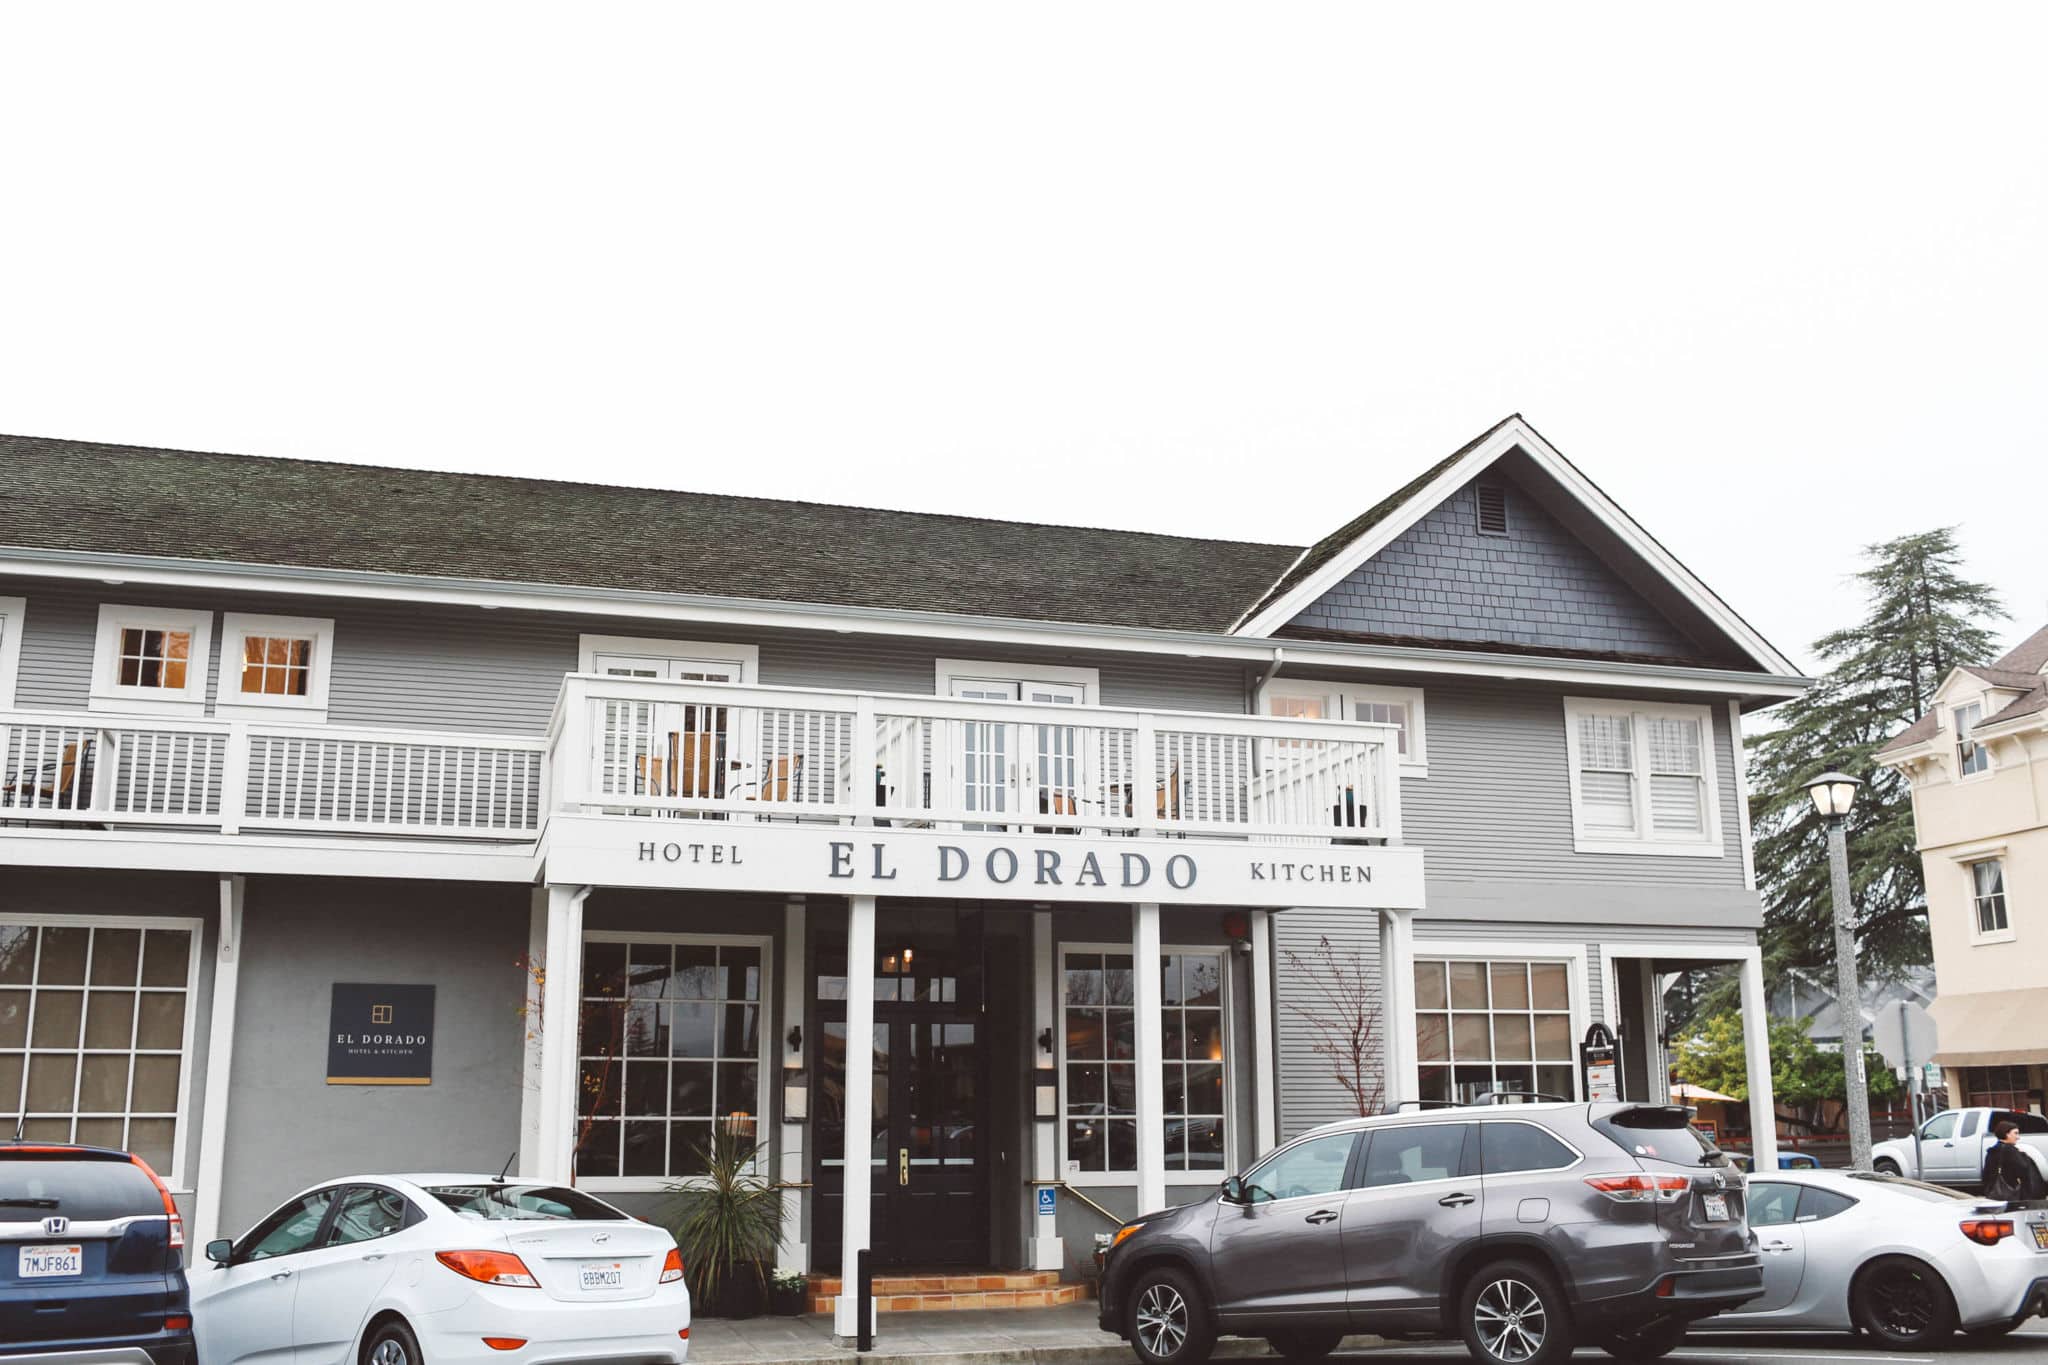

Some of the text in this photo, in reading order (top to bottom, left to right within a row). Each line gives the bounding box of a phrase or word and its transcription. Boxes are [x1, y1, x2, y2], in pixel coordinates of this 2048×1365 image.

[638, 841, 743, 865] HOTEL
[828, 841, 1197, 890] EL DORADO
[1250, 862, 1371, 883] KITCHEN
[337, 1034, 426, 1045] EL DORADO
[24, 1256, 77, 1272] 7MJF861
